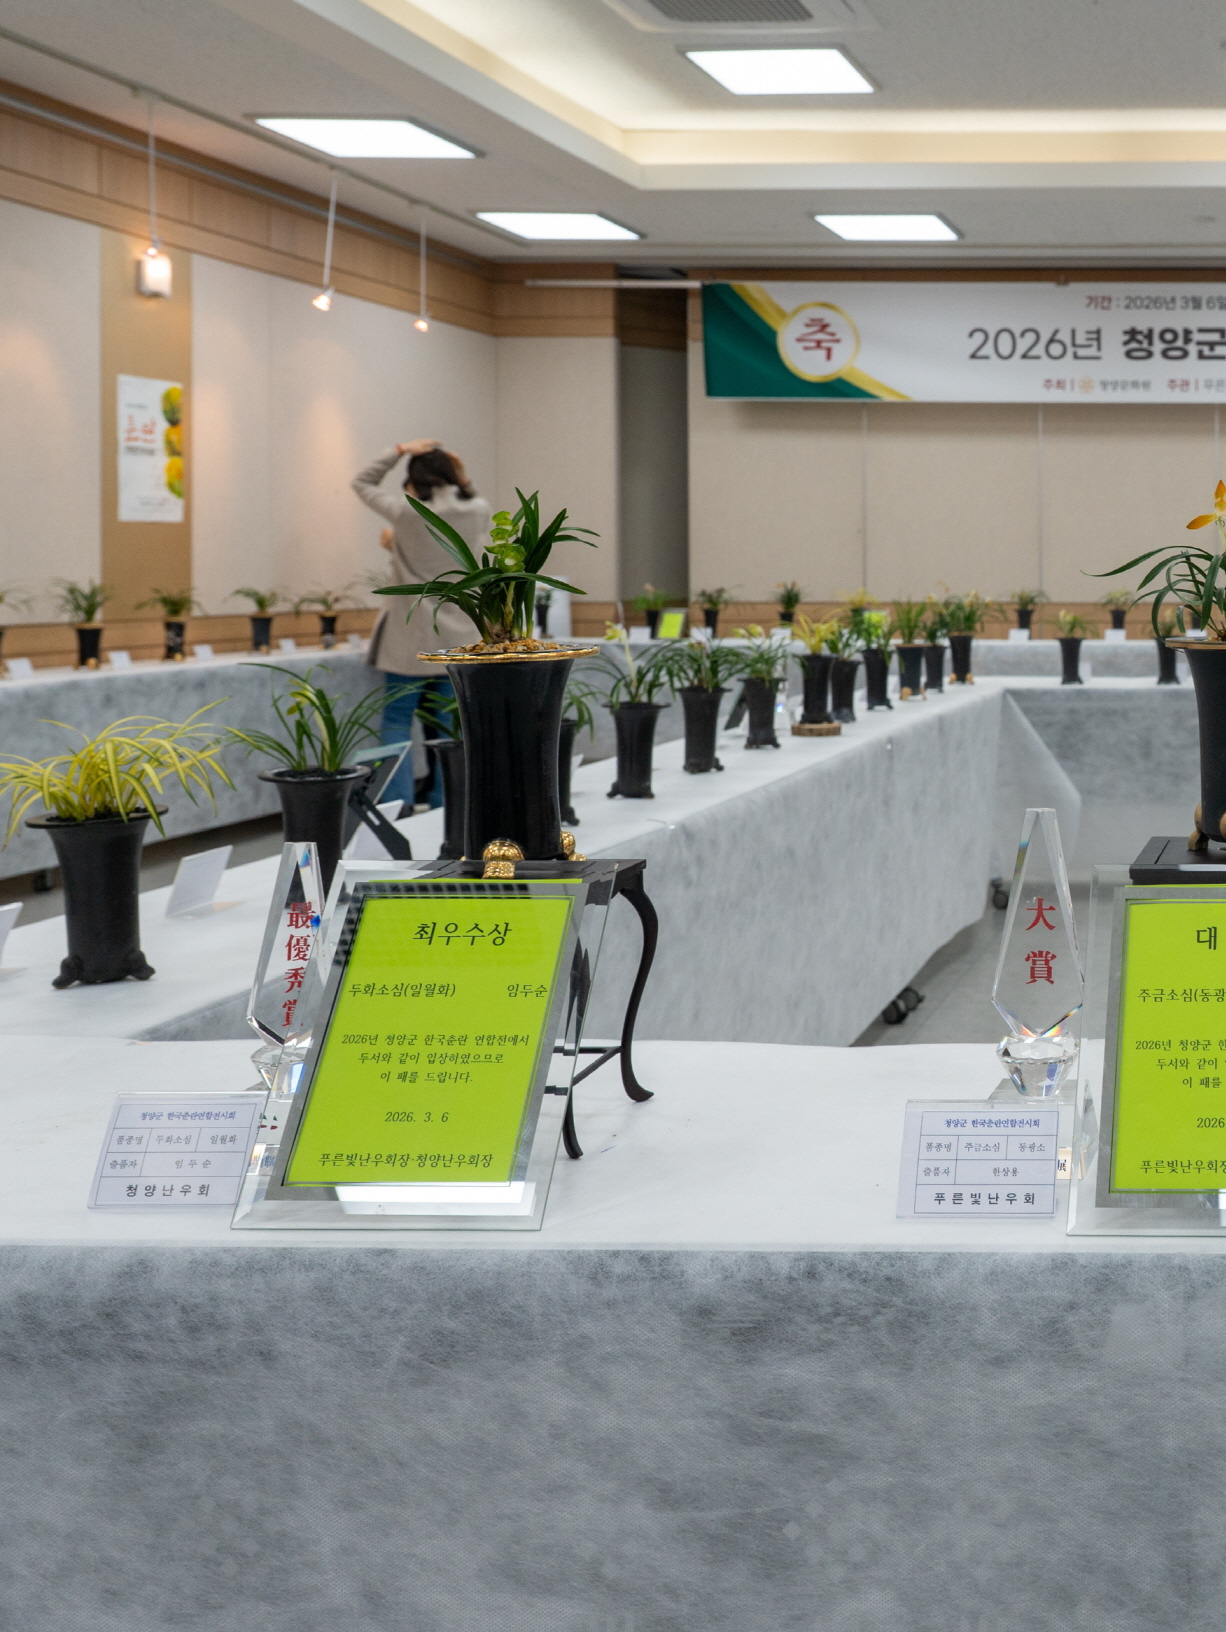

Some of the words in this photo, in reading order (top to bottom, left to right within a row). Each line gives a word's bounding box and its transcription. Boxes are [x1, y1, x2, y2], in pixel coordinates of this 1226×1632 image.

[1085, 294, 1113, 311] 기간
[1123, 294, 1177, 311] 2026년
[1179, 294, 1203, 311] 3월
[795, 317, 842, 362] 축
[967, 327, 1103, 360] 2026년
[413, 921, 512, 947] 최우수상
[1025, 898, 1057, 985] 大賞
[349, 983, 456, 998] 두화소심(일월화)
[507, 983, 548, 998] 임두순
[341, 1033, 378, 1046] 2026년
[384, 1033, 418, 1046] 청양군
[424, 1033, 468, 1046] 한국춘란
[474, 1033, 530, 1046] 연합전에서
[1135, 1039, 1172, 1051] 2026년
[1179, 1039, 1212, 1051] 청양군
[358, 1052, 392, 1065] 두서와
[398, 1052, 420, 1065] 같이
[427, 1052, 504, 1065] 입상하였으므로
[1156, 1058, 1190, 1070] 두서와
[1196, 1058, 1218, 1070] 같이
[380, 1071, 390, 1083] 이
[396, 1071, 419, 1083] 패를
[424, 1071, 473, 1083] 드립니다.
[1182, 1076, 1192, 1088] 이
[1200, 1076, 1221, 1088] 패를
[140, 1111, 163, 1121] 청양군
[384, 1111, 416, 1123] 2026.
[423, 1111, 434, 1123] 3.
[441, 1111, 449, 1123] 6
[944, 1118, 968, 1128] 청양군
[156, 1134, 192, 1145] 두화소심
[210, 1134, 237, 1145] 일월화
[964, 1142, 1000, 1152] 주금소심
[1018, 1142, 1046, 1152] 동광소
[992, 1166, 1019, 1177] 한상용
